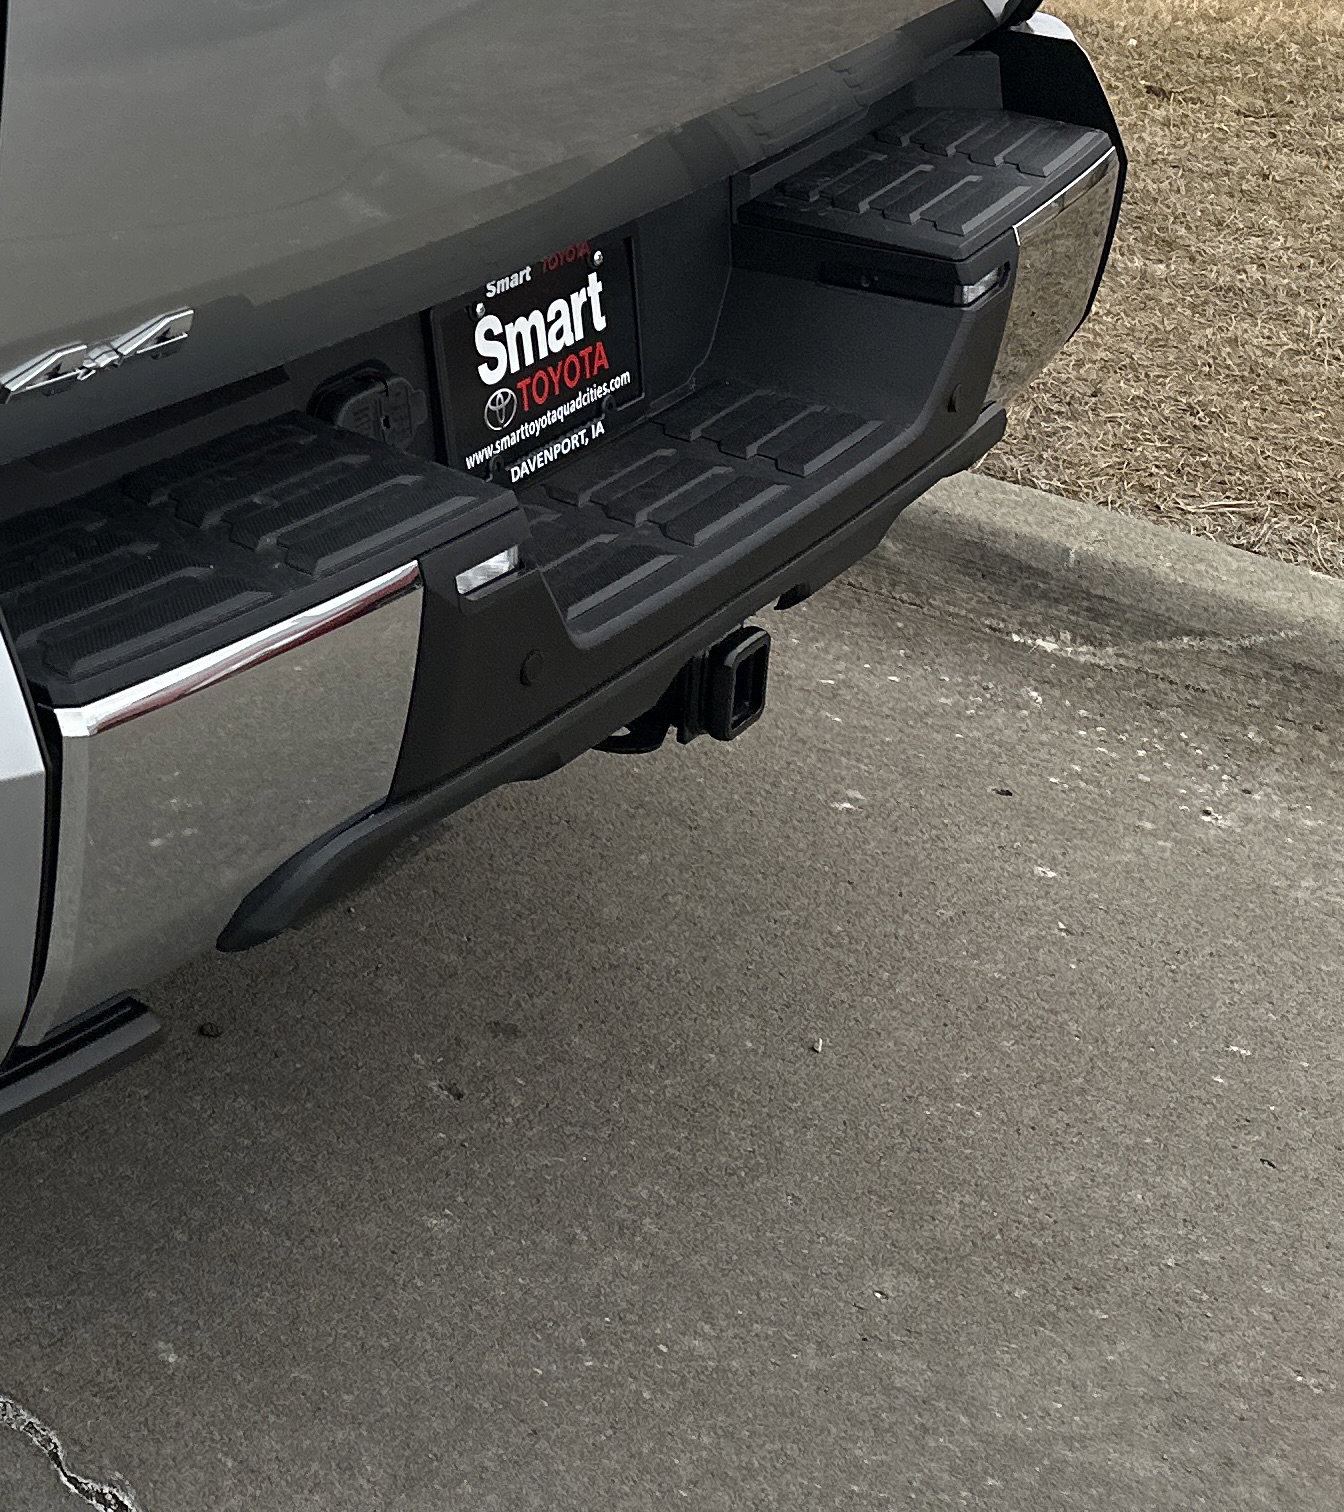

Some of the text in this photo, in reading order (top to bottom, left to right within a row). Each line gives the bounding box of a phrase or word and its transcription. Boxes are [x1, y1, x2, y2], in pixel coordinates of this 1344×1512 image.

[485, 239, 591, 298] Smart TOYOTA
[474, 271, 607, 386] Smart
[517, 341, 609, 412] TOYOTA
[465, 371, 631, 470] www.smarttoyotaquadcities.com
[510, 420, 605, 483] DAVENPORT, IA
